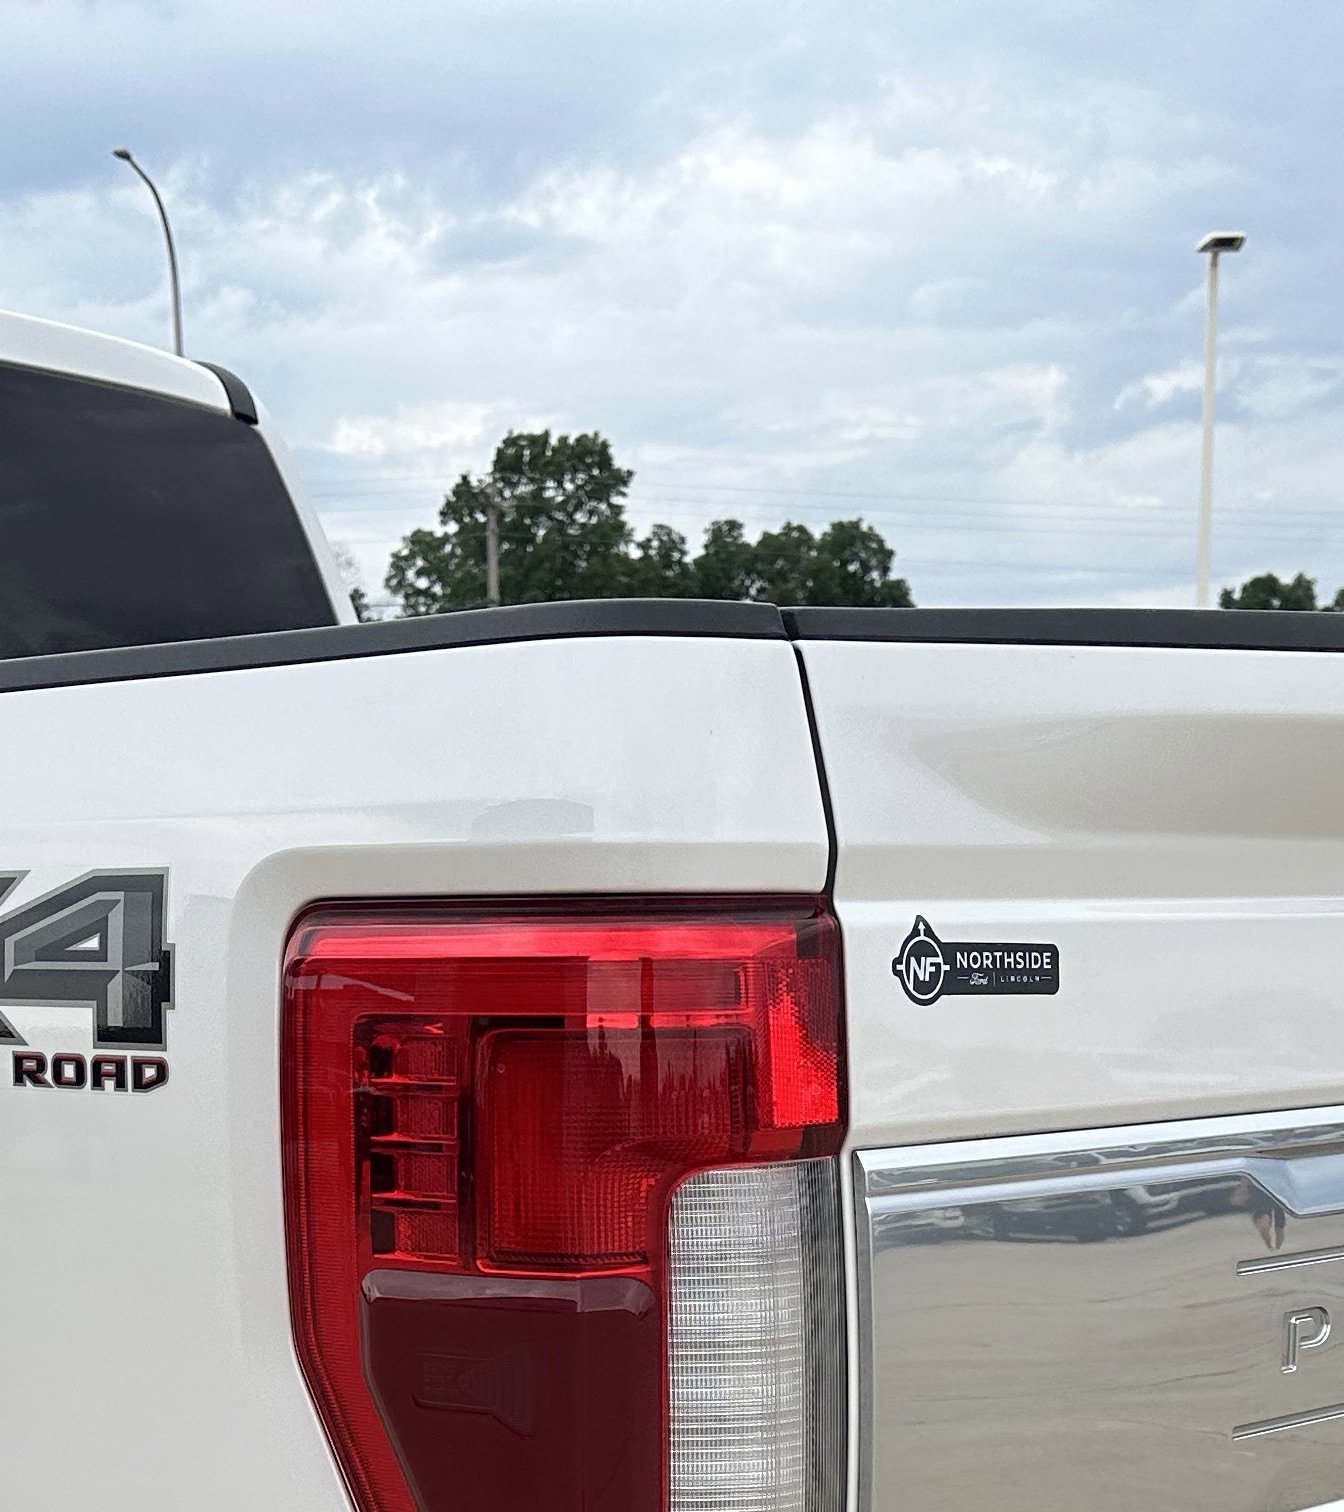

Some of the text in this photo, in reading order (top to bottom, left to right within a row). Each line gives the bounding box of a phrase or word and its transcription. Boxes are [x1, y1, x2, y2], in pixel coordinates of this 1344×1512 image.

[909, 956, 943, 987] NF
[956, 951, 1052, 969] NORTHSIDE
[969, 972, 1040, 986] Ford LINCOLN
[11, 1050, 170, 1094] ROAD
